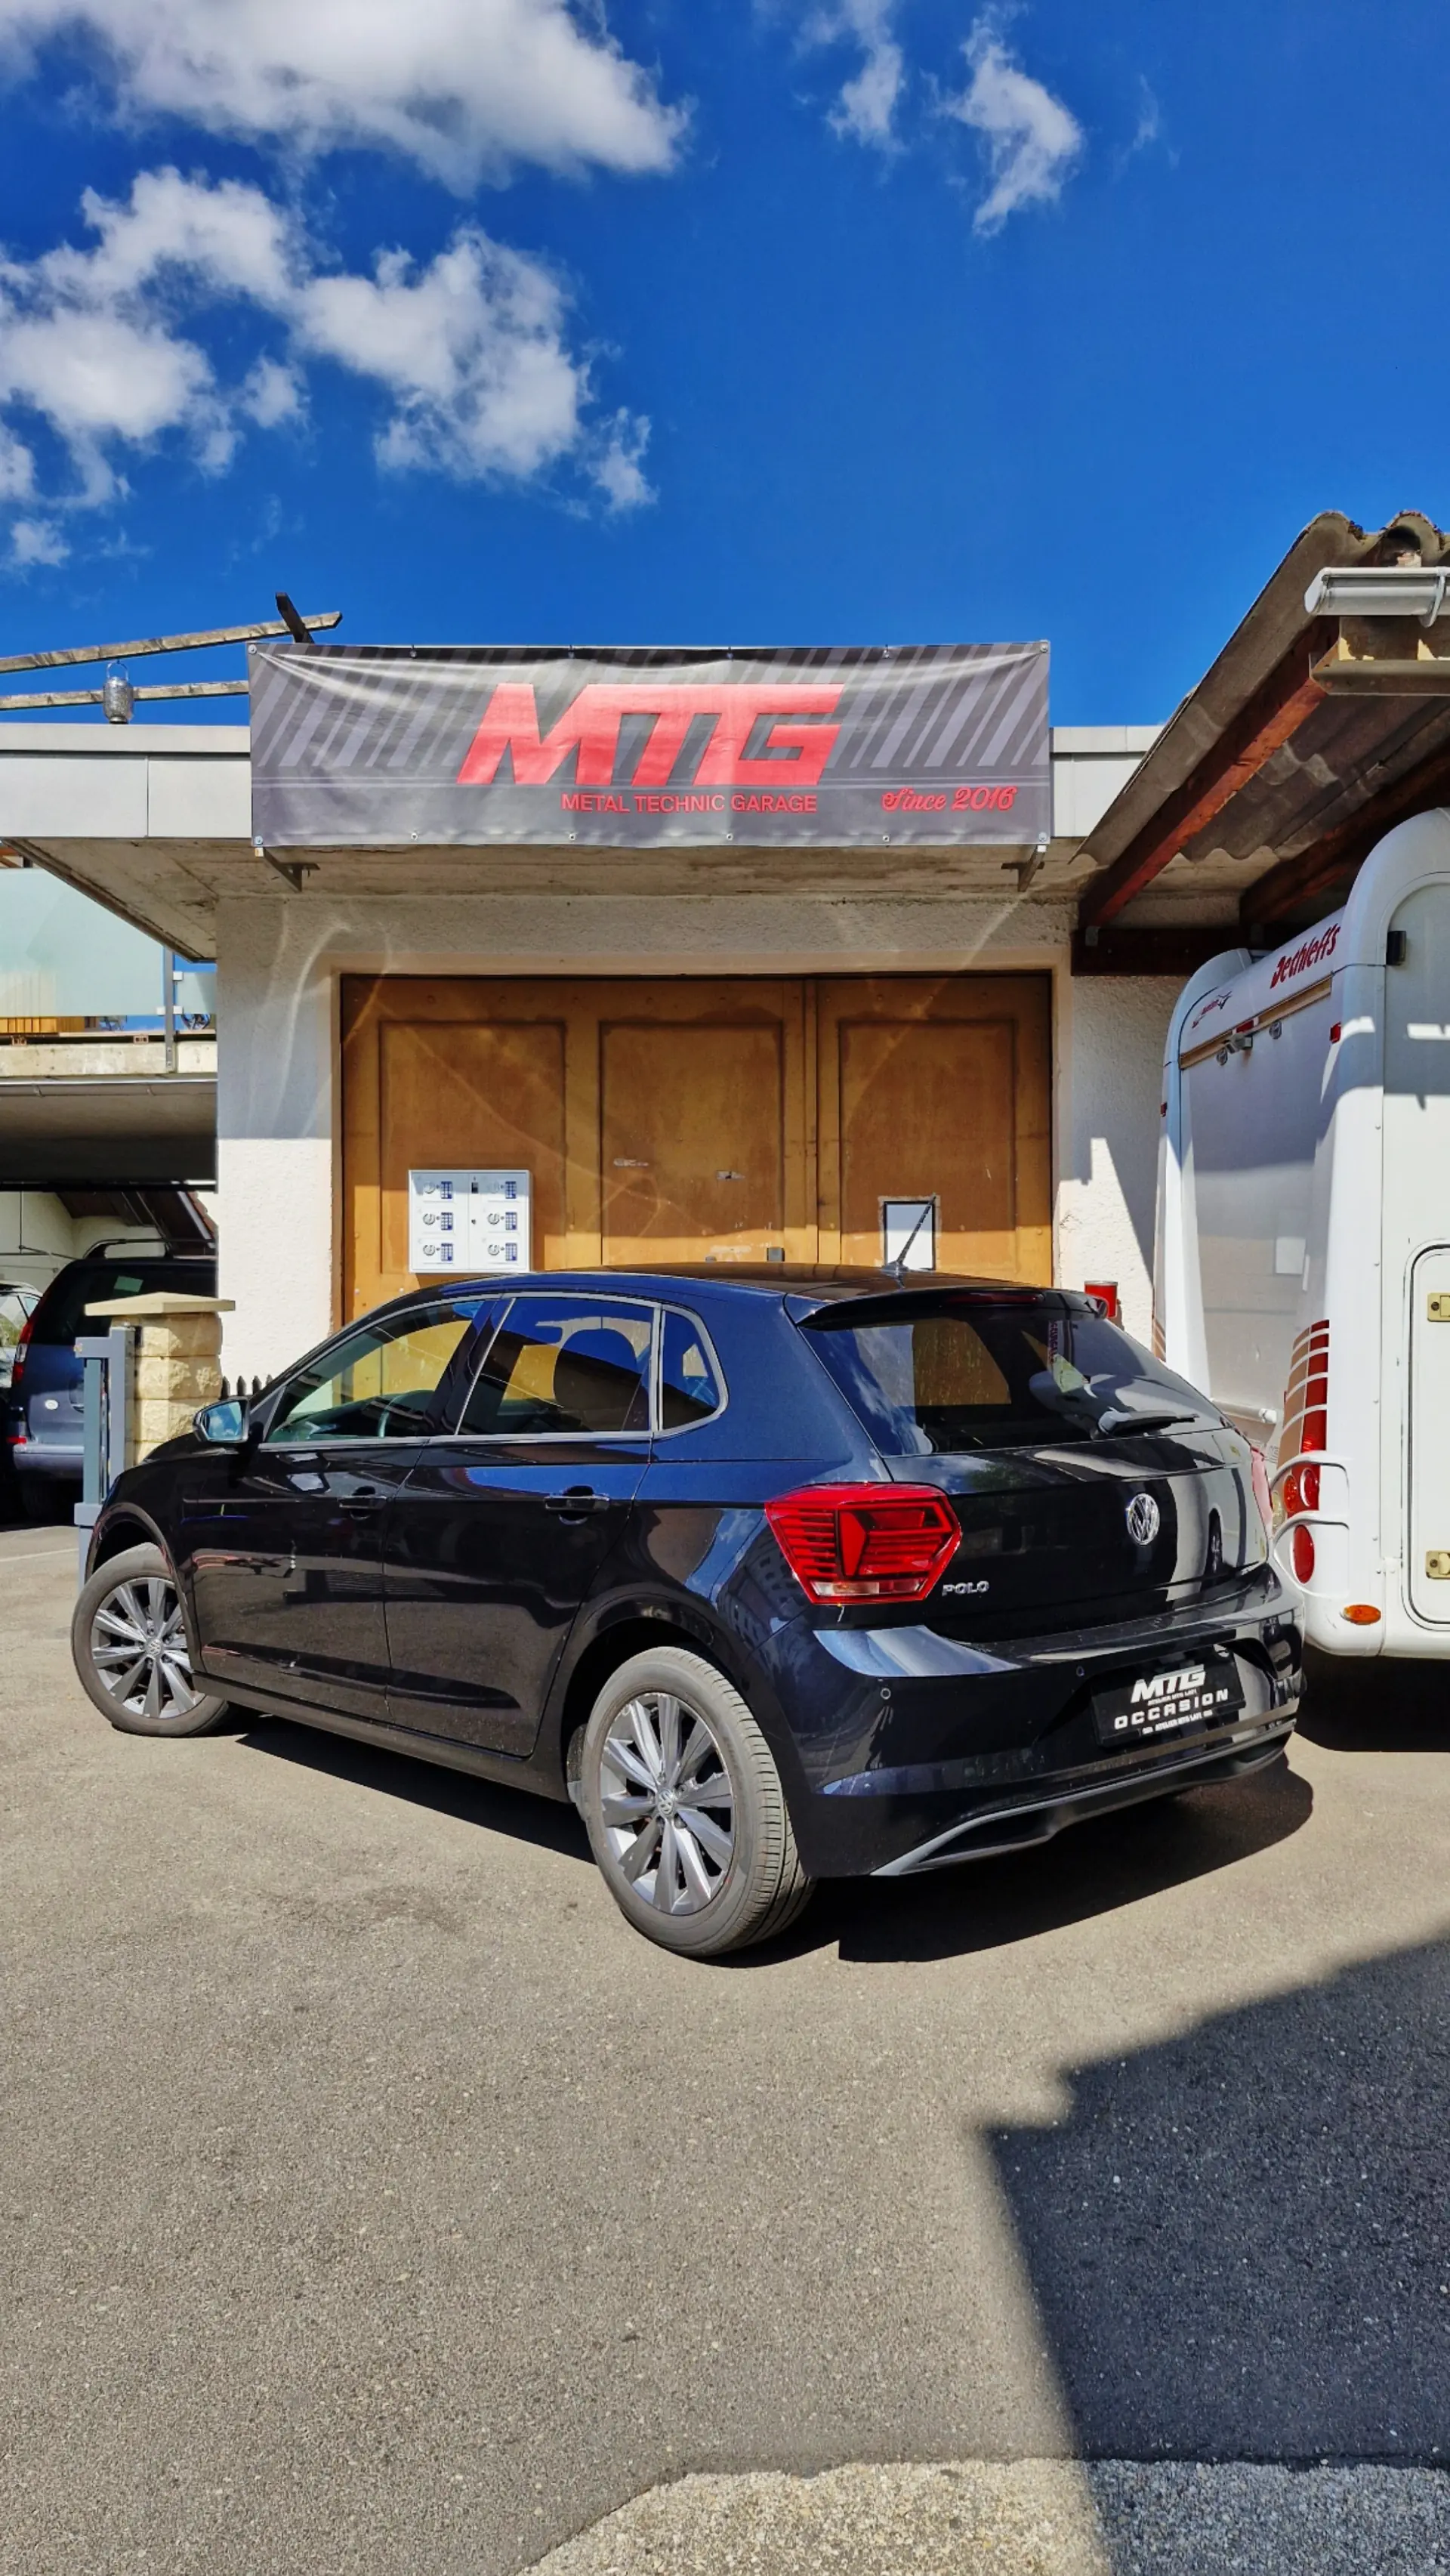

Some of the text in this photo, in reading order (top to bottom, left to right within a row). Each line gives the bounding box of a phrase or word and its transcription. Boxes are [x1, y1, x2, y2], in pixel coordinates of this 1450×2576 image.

[457, 684, 845, 786] MTG
[561, 793, 817, 814] METAL TECHNIC GARAGE
[881, 786, 1017, 812] Since 2016
[942, 1580, 990, 1596] POLO
[1131, 1664, 1205, 1703] MTG
[1114, 1688, 1229, 1730] OCCASION
